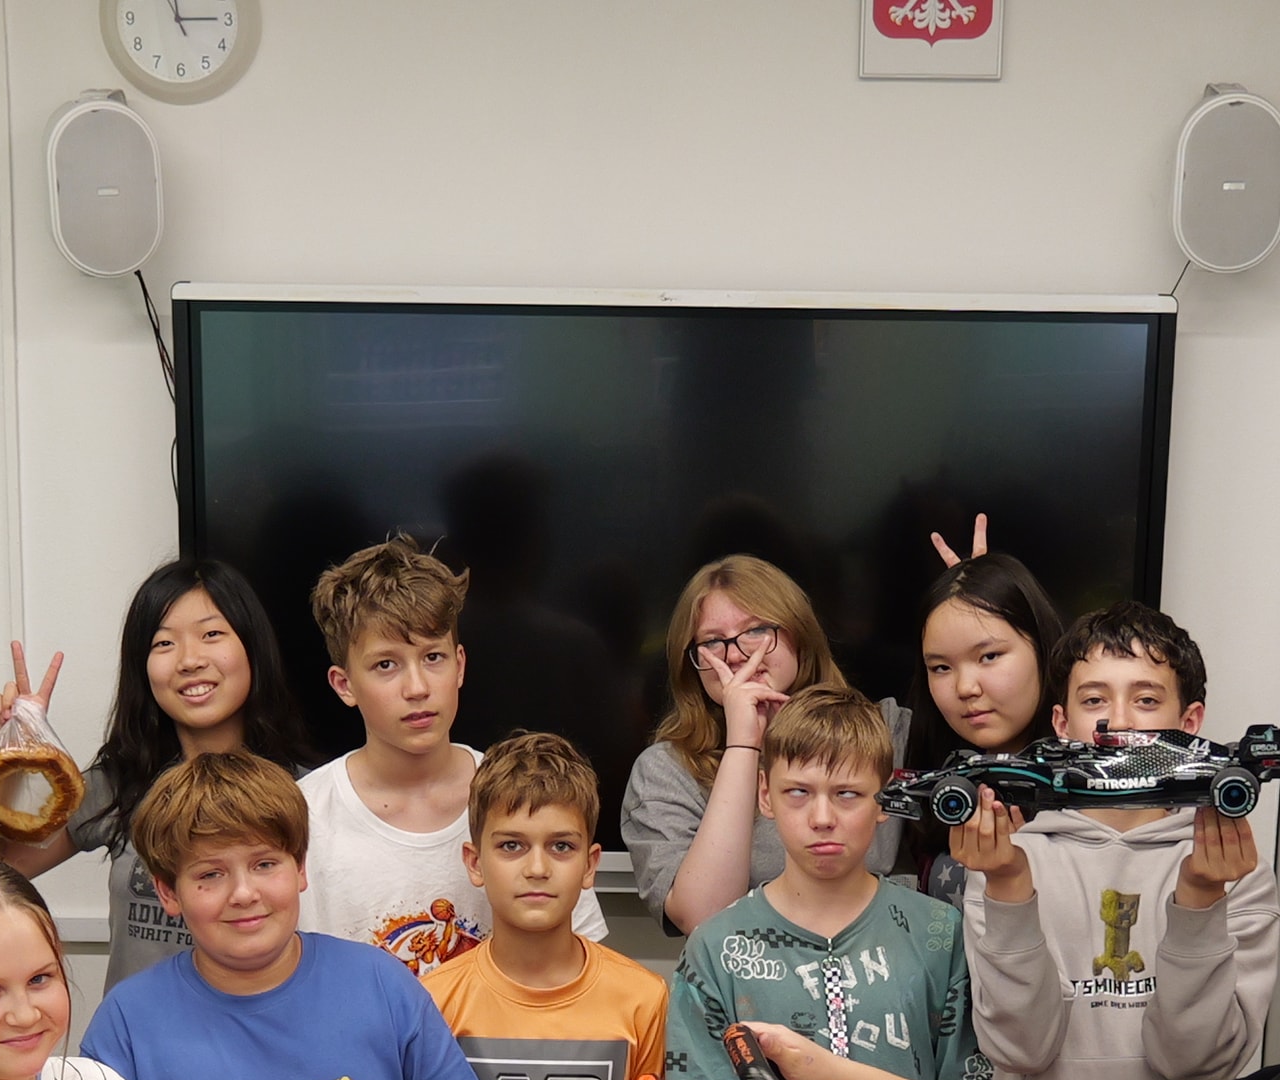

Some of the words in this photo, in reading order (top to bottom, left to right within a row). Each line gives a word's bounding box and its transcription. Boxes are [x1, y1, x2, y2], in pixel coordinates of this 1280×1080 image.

[125, 12, 135, 25] 9
[224, 13, 233, 26] 3
[133, 37, 143, 51] 8
[218, 38, 228, 51] 4
[153, 55, 162, 69] 7
[201, 56, 210, 69] 5
[176, 63, 186, 77] 6
[1187, 738, 1210, 753] 44
[1086, 777, 1158, 790] PETRONAS
[128, 924, 172, 942] SPIRIT
[176, 931, 196, 946] FO
